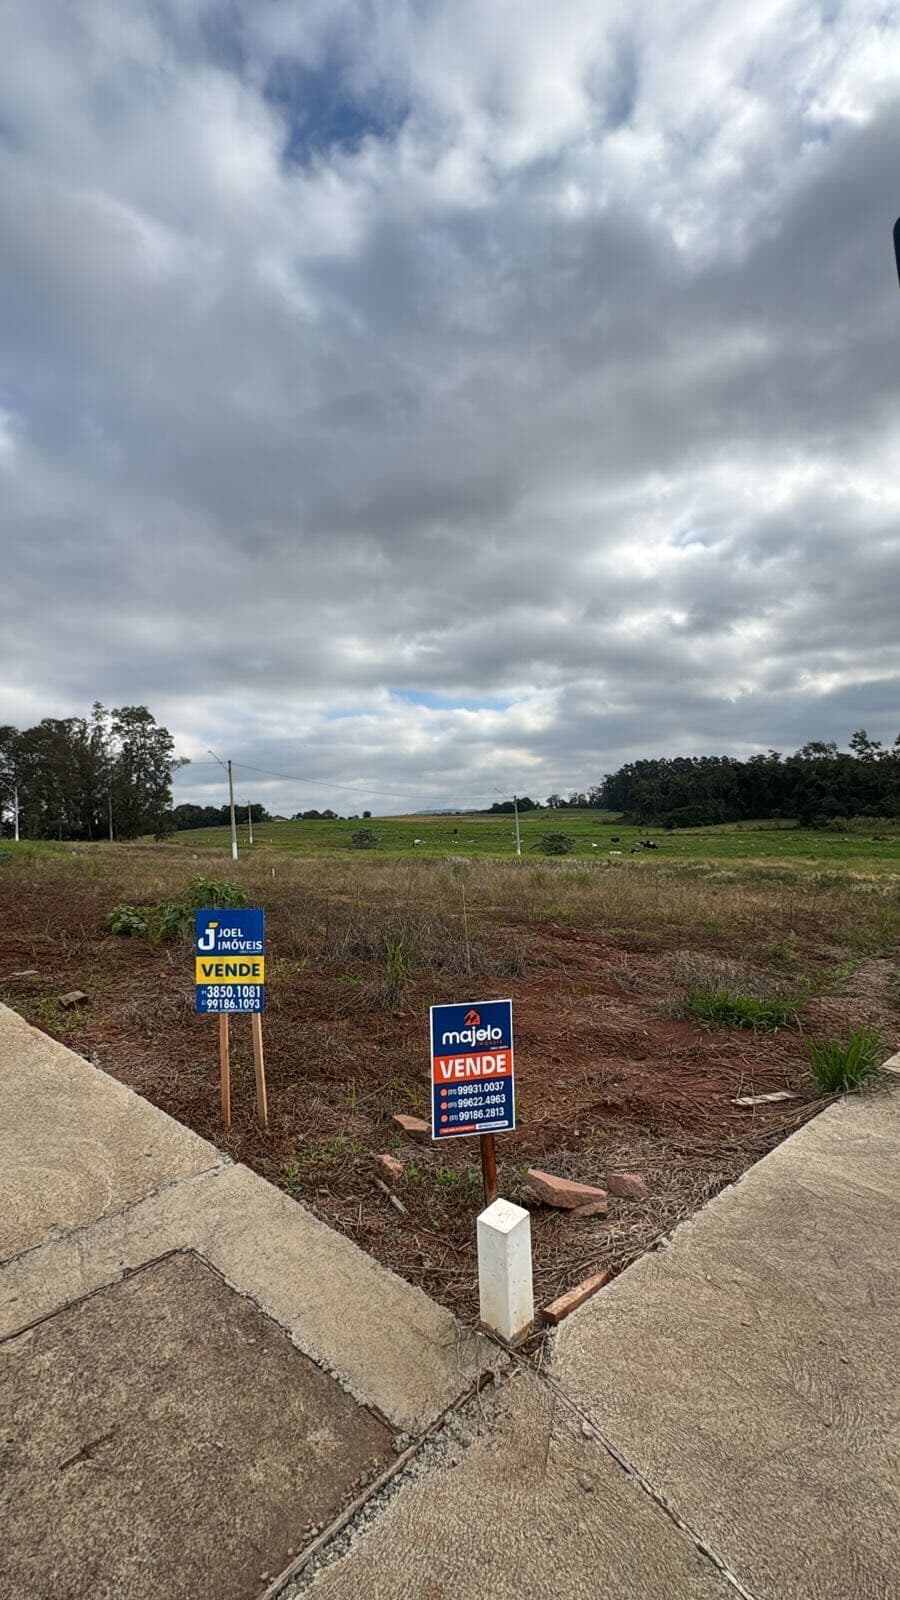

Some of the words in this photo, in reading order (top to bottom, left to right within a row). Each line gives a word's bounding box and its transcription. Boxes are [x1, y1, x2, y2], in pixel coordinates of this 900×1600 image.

[218, 928, 244, 938] JOEL
[218, 938, 262, 950] IMÓVEIS
[201, 963, 260, 977] VENDE
[206, 986, 260, 998] 3850.1081
[206, 998, 260, 1008] 99186.1093
[442, 1024, 502, 1047] majelo
[440, 1054, 506, 1078] VENDE
[458, 1081, 504, 1095] 99931.0037
[458, 1094, 506, 1108] 99622.4963
[458, 1107, 504, 1121] 99186.2813
